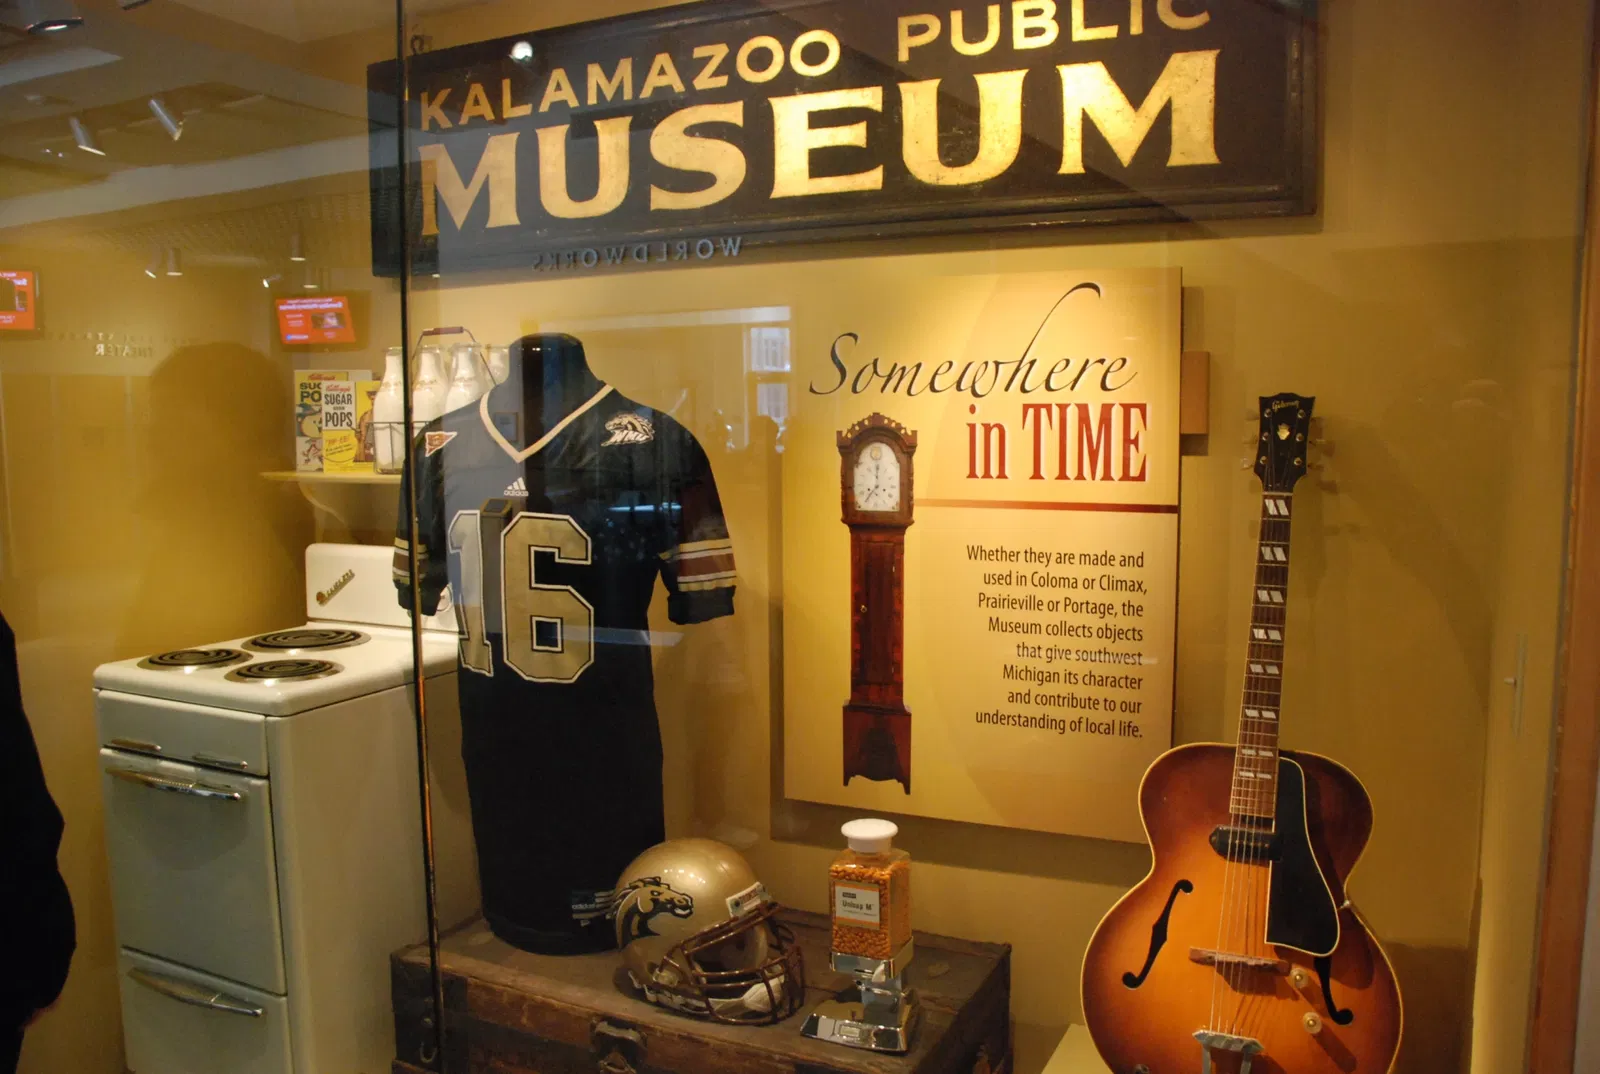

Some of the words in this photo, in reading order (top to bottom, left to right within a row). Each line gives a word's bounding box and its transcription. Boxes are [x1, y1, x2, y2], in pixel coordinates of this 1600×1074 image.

[420, 29, 841, 131] KALAMAZOO
[898, 0, 1210, 63] PUBLIC
[418, 49, 1221, 236] MUSEUM
[809, 282, 1138, 399] Somewhere
[324, 393, 353, 405] SUGAR
[325, 412, 353, 428] POPS
[966, 403, 1009, 480] in
[1022, 403, 1147, 482] TIME
[966, 544, 1021, 563] Whether
[1024, 547, 1052, 568] they
[1055, 552, 1075, 566] are
[1079, 550, 1116, 567] made
[1119, 551, 1144, 568] and
[449, 509, 594, 683] 16
[983, 570, 1012, 587] used
[1016, 571, 1027, 587] in
[1031, 571, 1078, 590] Coloma
[1082, 576, 1096, 591] or
[1099, 574, 1148, 595] Climax,
[978, 592, 1044, 612] Prairieville
[1047, 599, 1060, 613] or
[1063, 597, 1118, 619] Portage,
[1122, 600, 1144, 618] the
[988, 616, 1042, 635] Museum
[1045, 620, 1093, 639] collects
[1096, 624, 1143, 644] objects
[1016, 642, 1042, 659] that
[1045, 644, 1072, 664] give
[1075, 647, 1143, 666] southwest
[1002, 664, 1060, 686] Michigan
[1063, 669, 1079, 685] its
[1082, 671, 1143, 690] character
[1007, 689, 1031, 704] and
[1034, 692, 1100, 711] contribute
[1103, 697, 1117, 712] to
[1120, 700, 1142, 714] our
[975, 709, 1066, 735] understanding
[1069, 717, 1083, 733] of
[1085, 717, 1115, 736] local
[1119, 720, 1143, 738] life.
